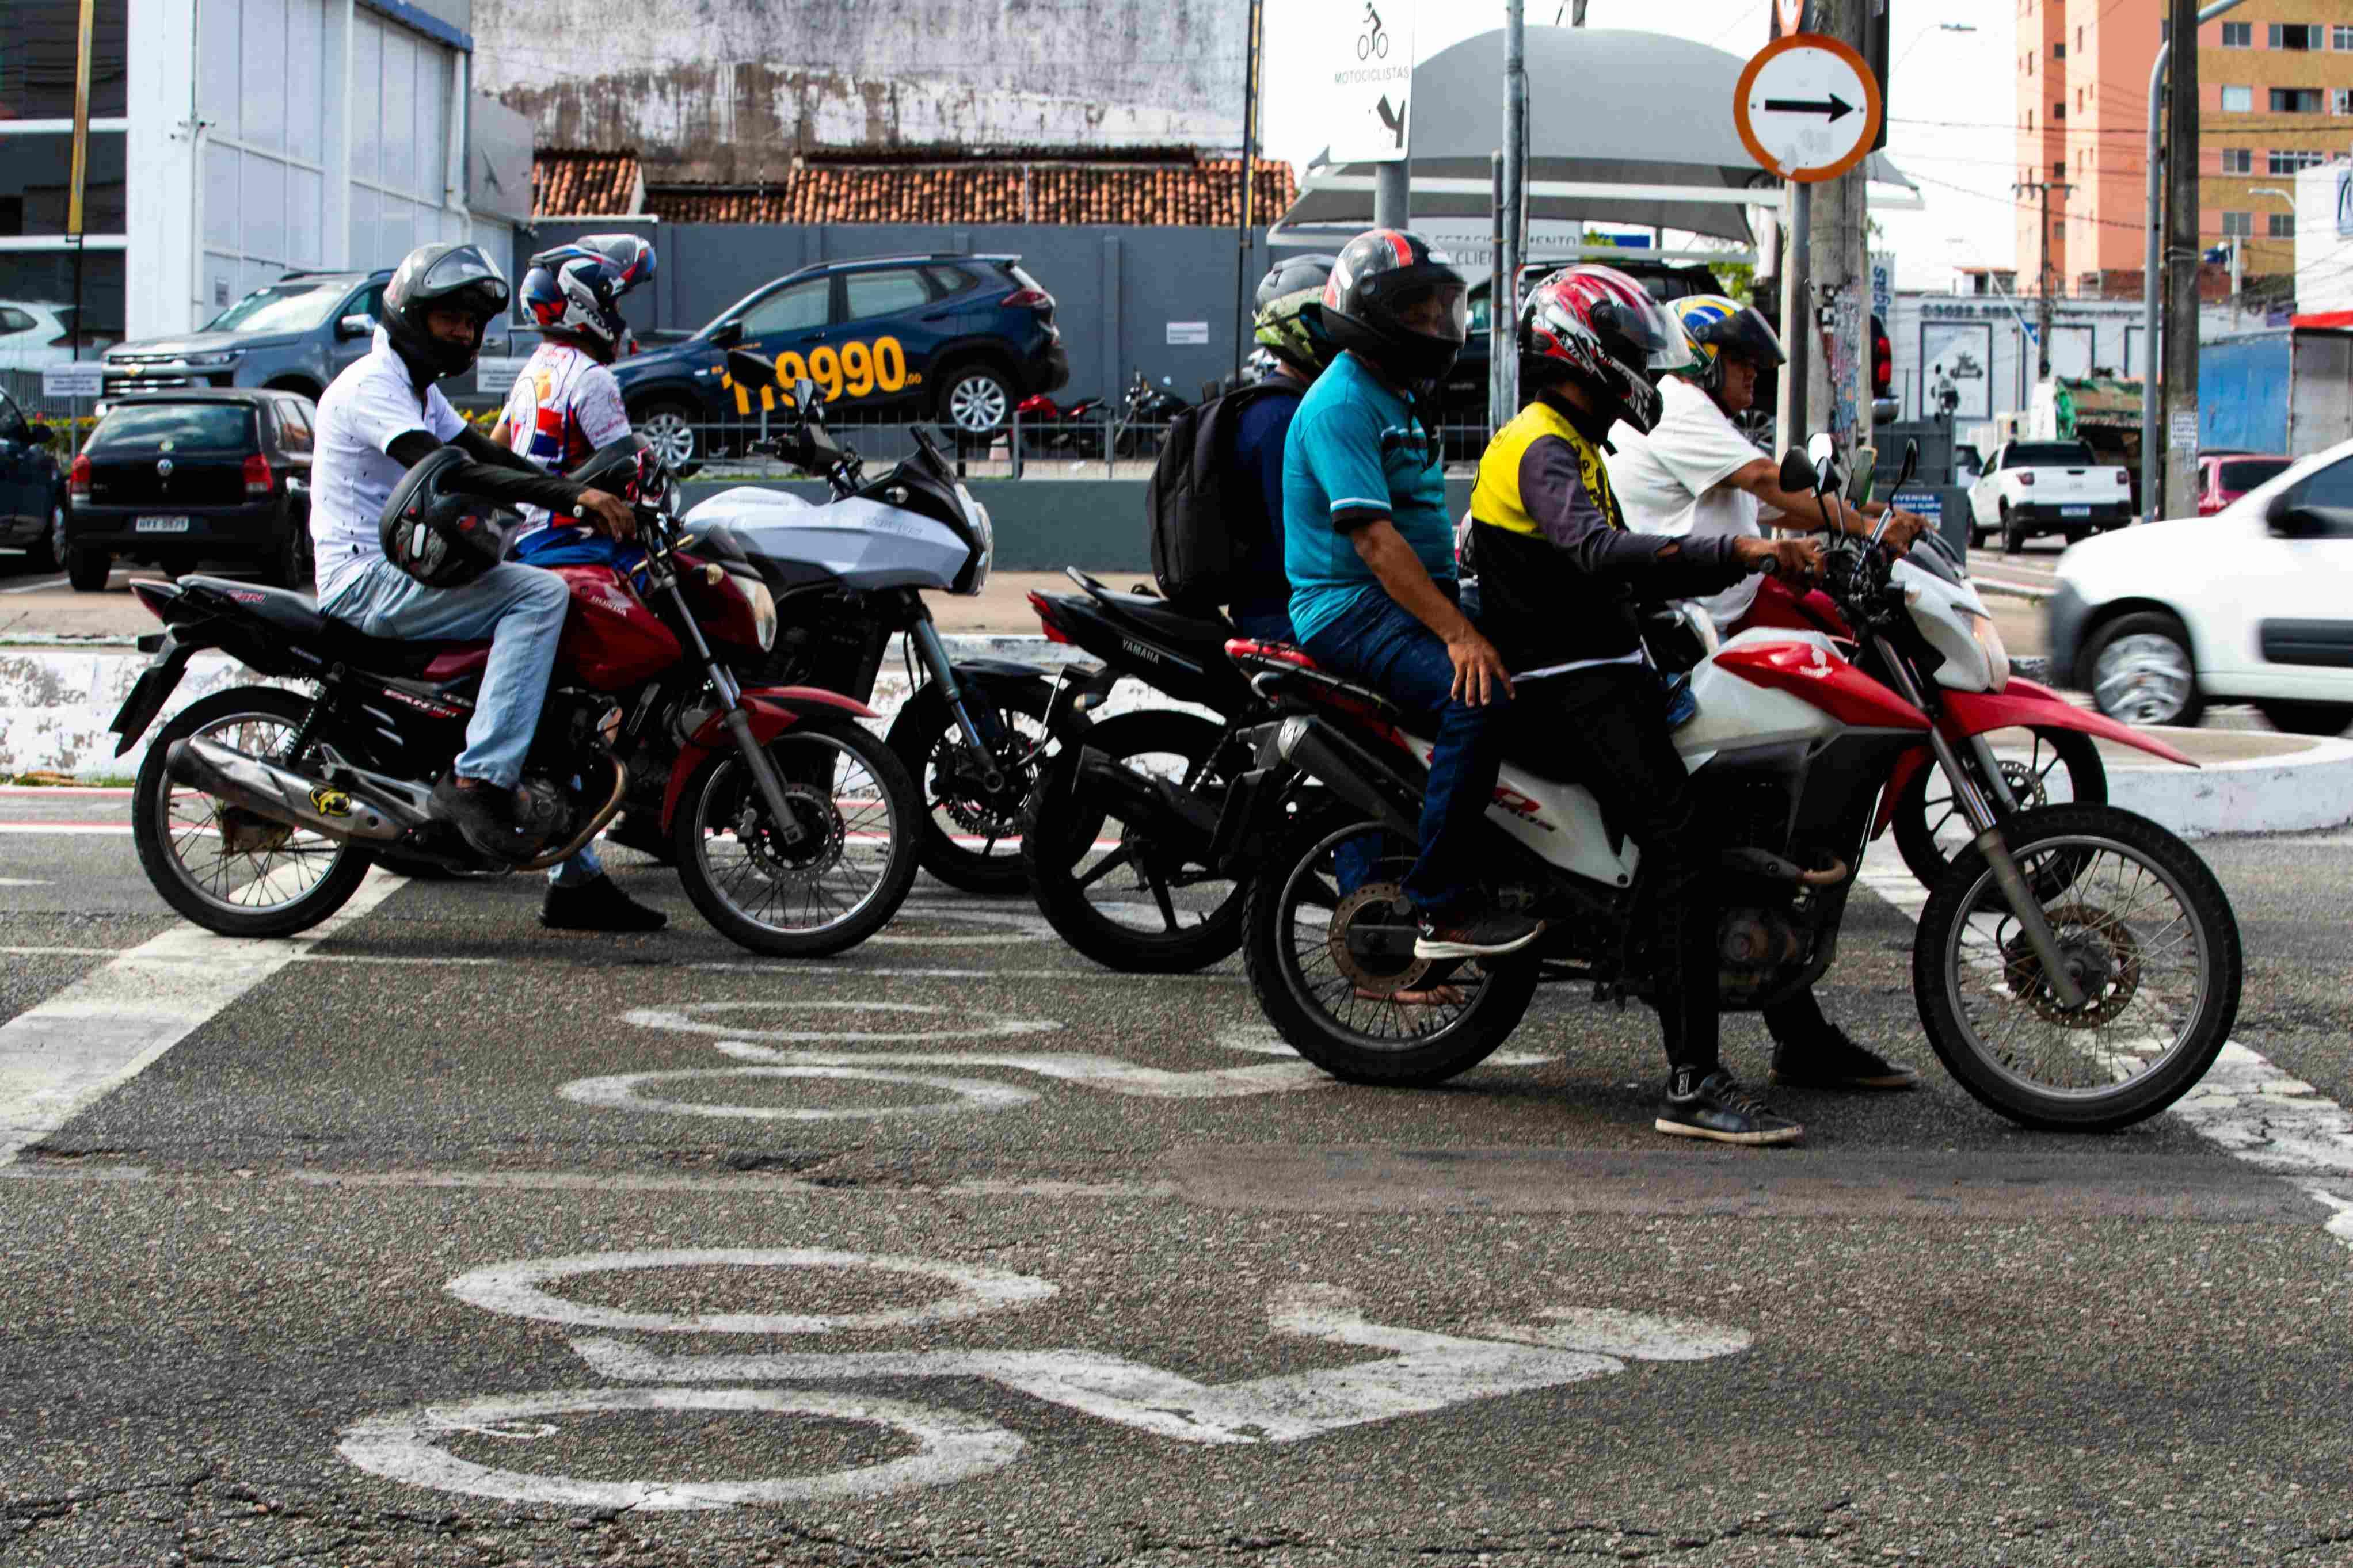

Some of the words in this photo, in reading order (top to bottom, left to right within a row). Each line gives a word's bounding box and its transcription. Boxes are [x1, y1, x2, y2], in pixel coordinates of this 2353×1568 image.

[1334, 65, 1410, 85] MOTOCICLISTAS
[589, 594, 627, 617] HONDA
[1122, 638, 1160, 664] YAMAHA
